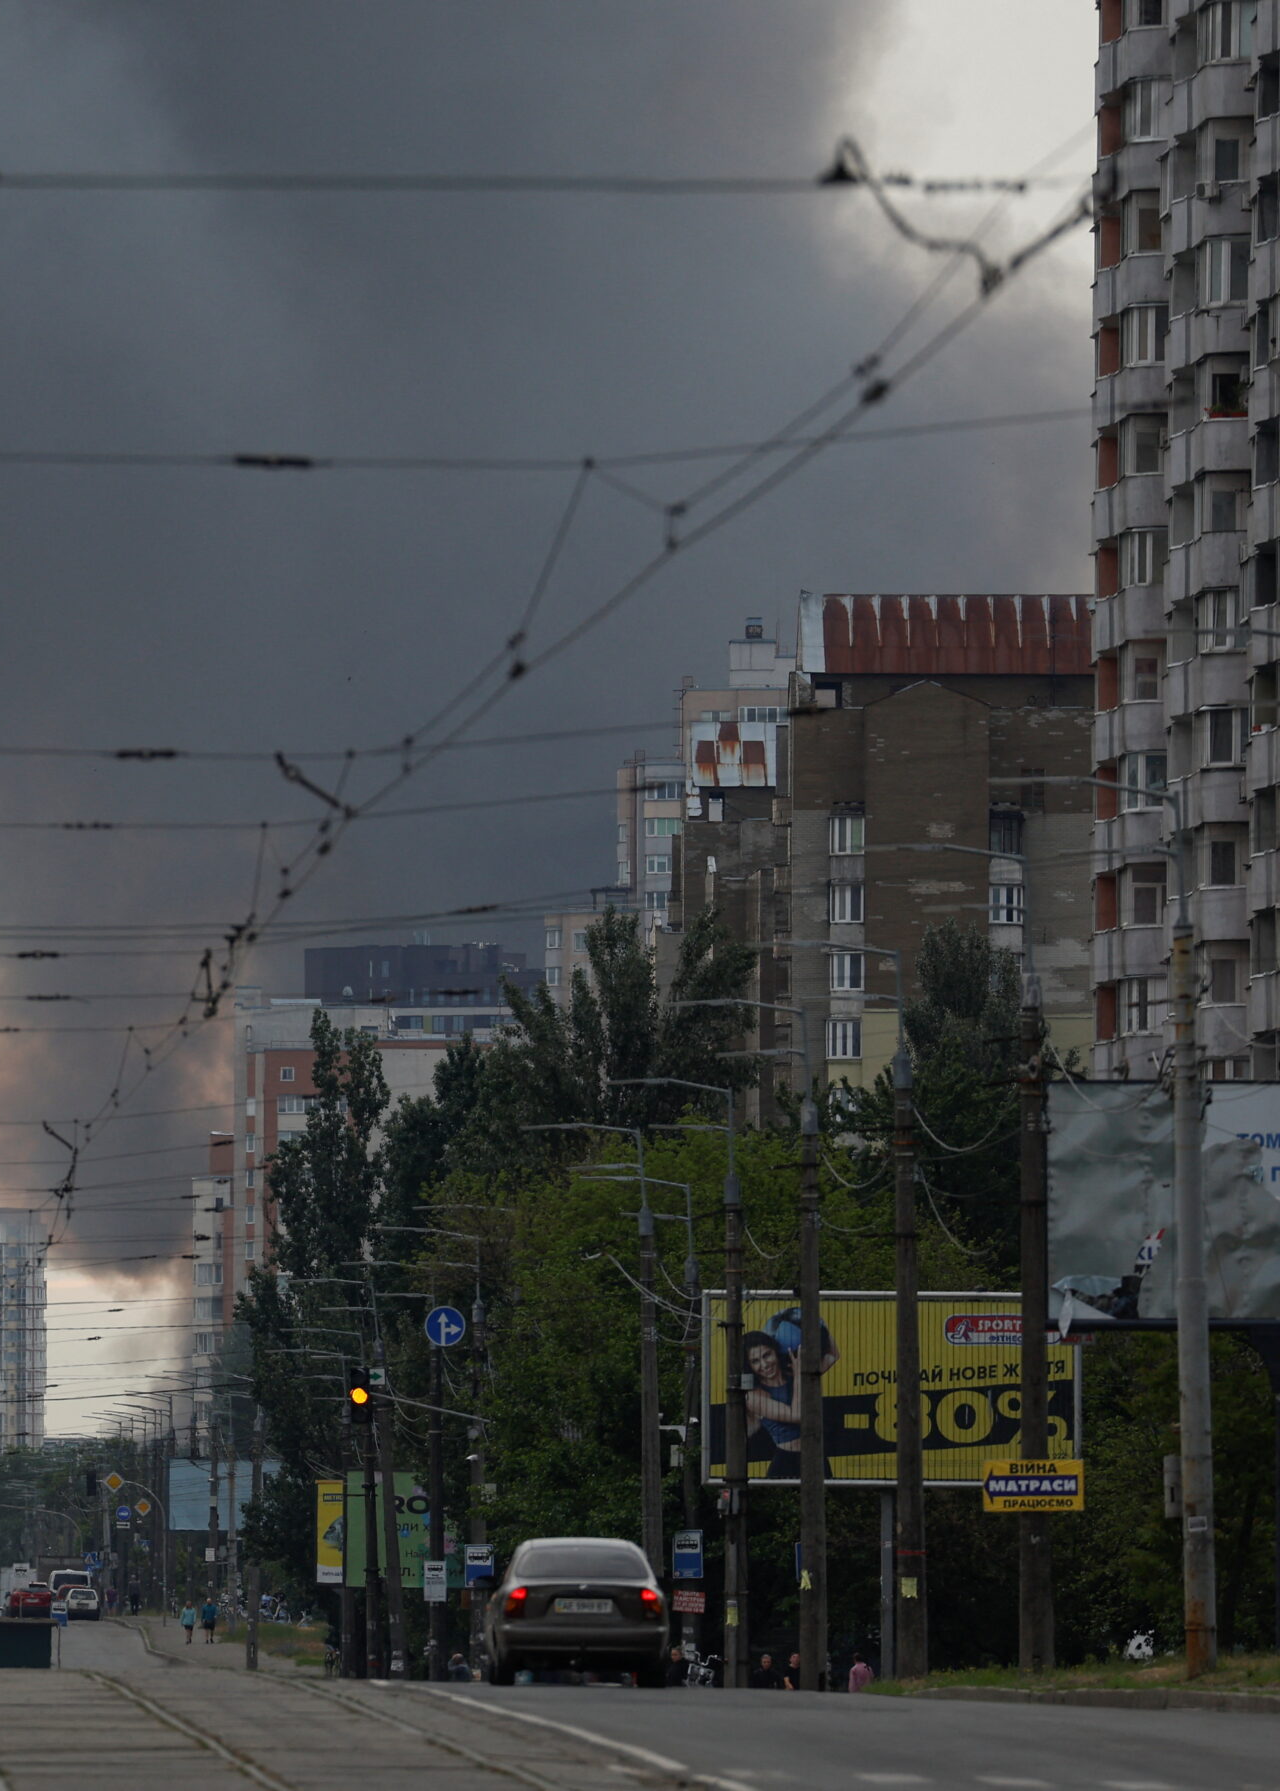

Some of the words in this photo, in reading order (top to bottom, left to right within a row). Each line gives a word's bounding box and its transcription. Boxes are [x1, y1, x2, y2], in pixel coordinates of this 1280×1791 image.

[977, 1319, 1022, 1331] SPORT
[853, 1365, 943, 1386] ПОЧАЙ
[949, 1365, 998, 1381] НОВЕ
[1003, 1360, 1065, 1377] ЖТЯ
[988, 1479, 1077, 1492] МАТРАСИ
